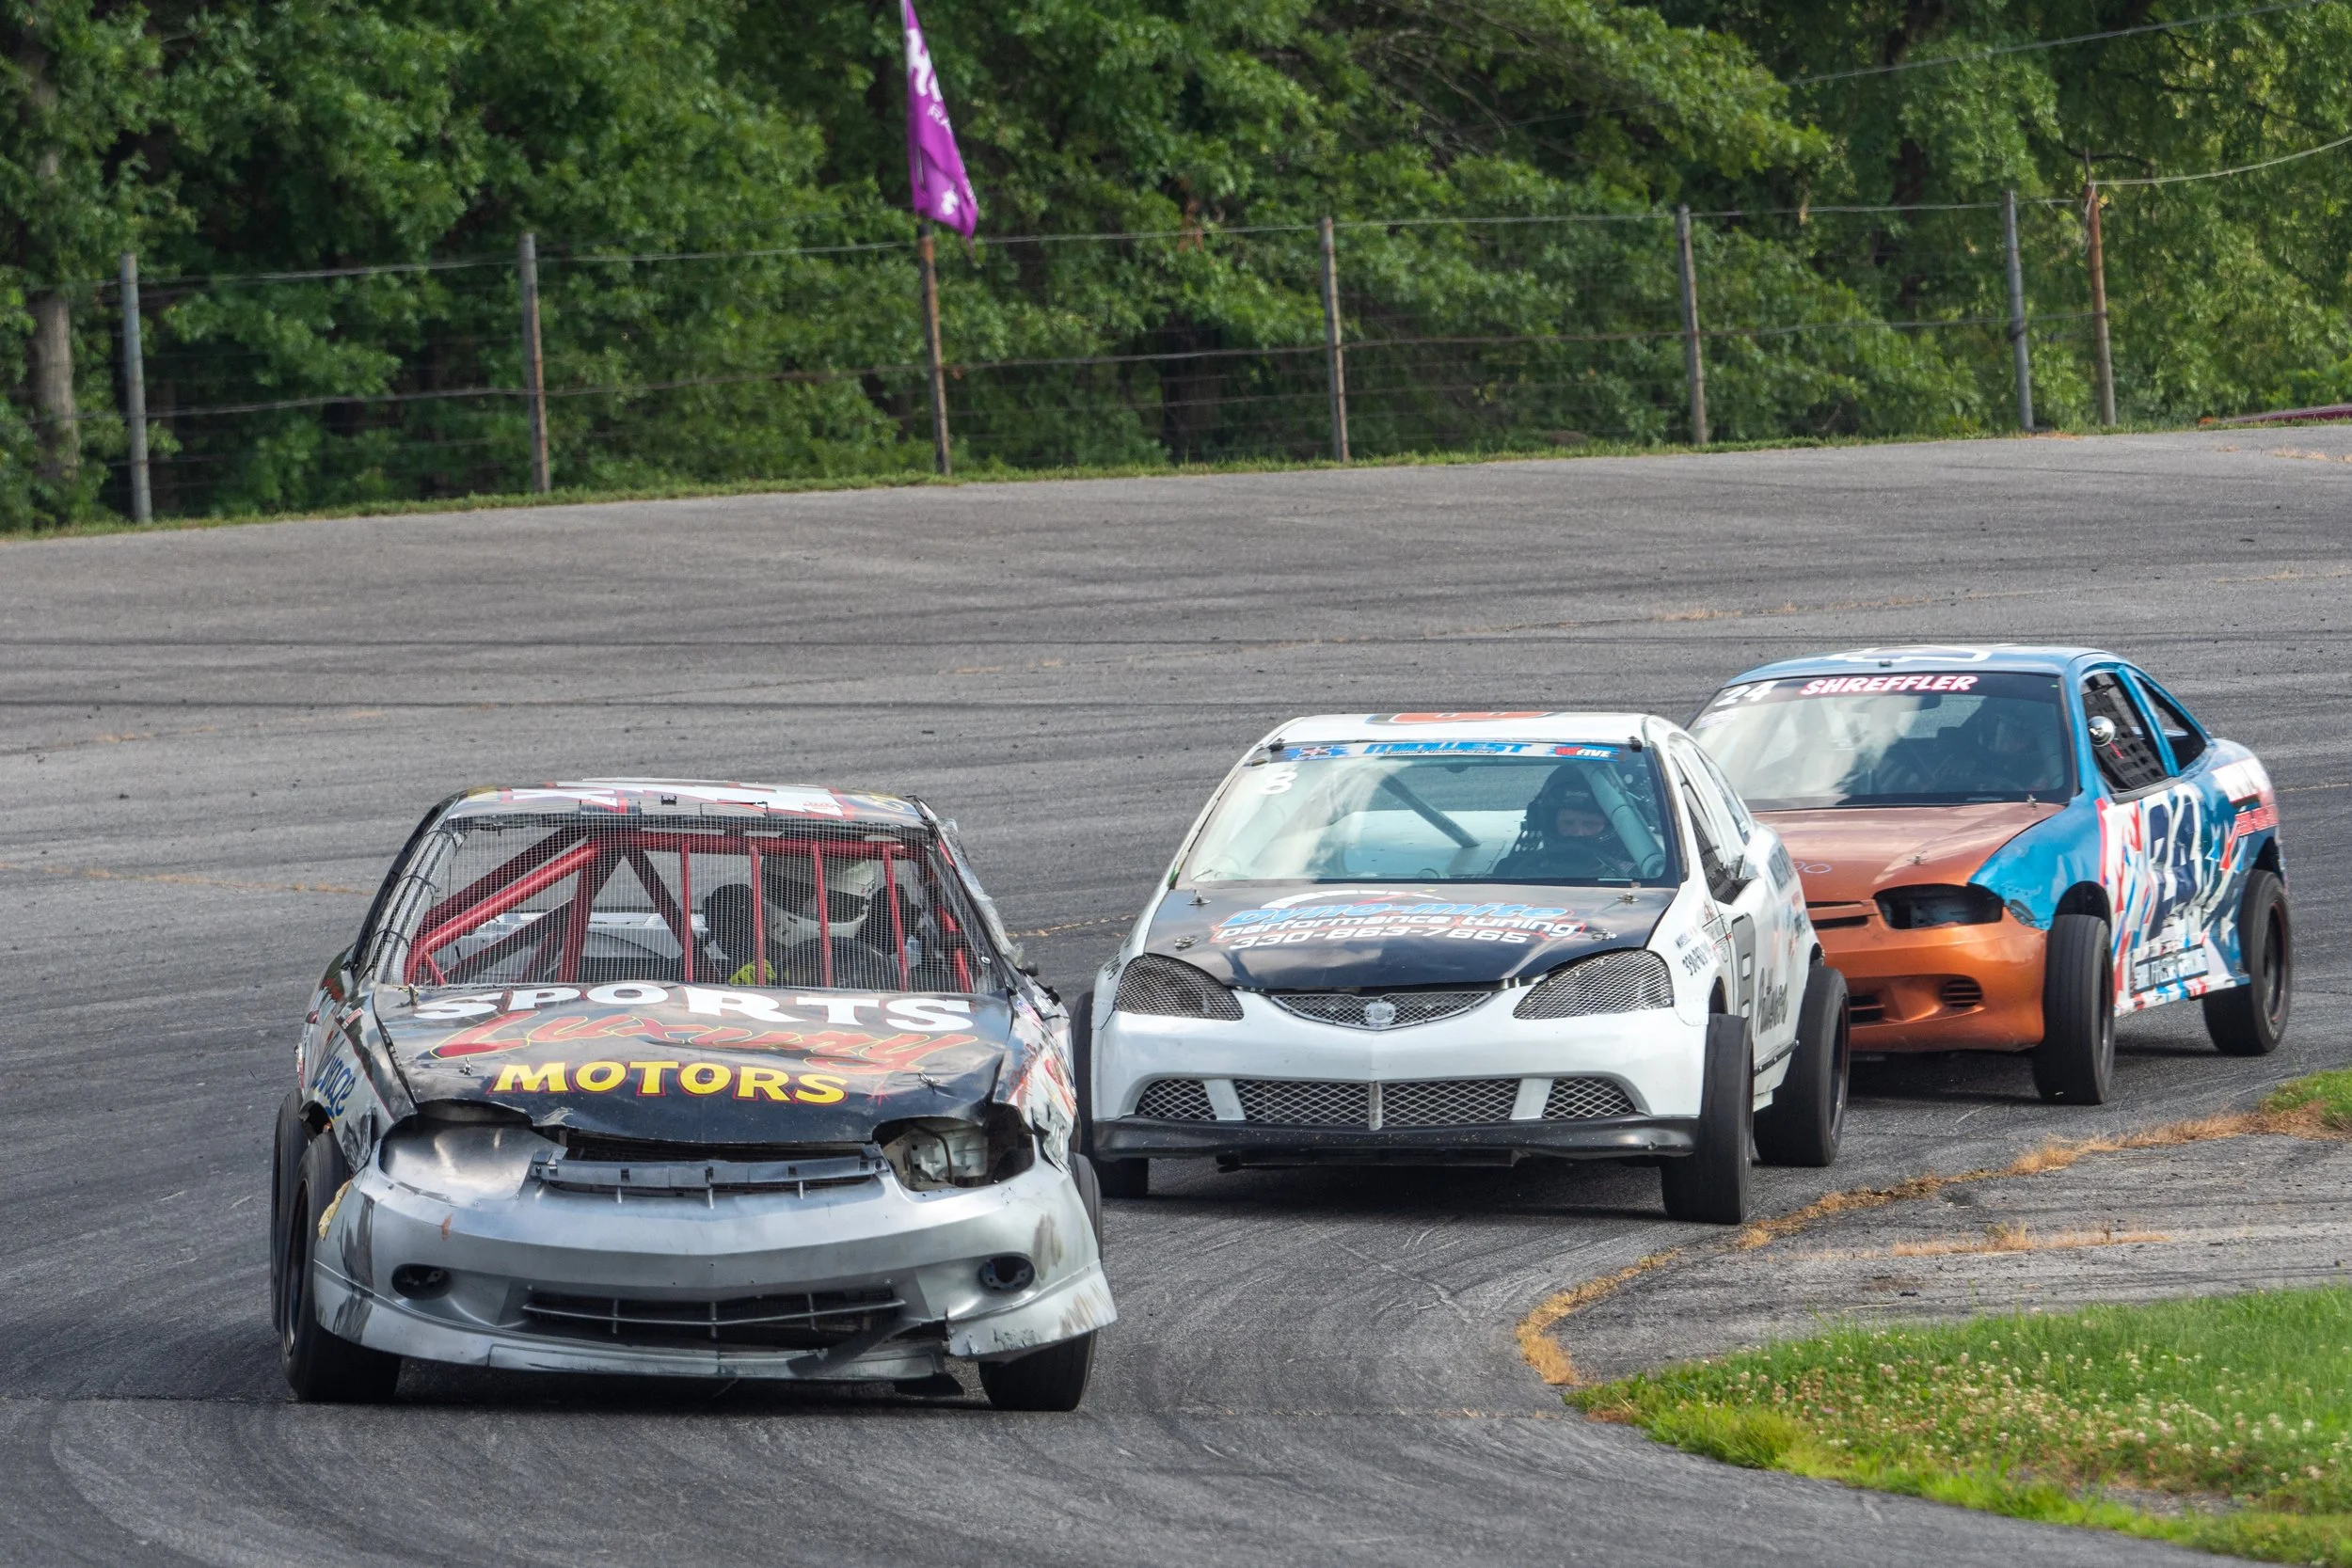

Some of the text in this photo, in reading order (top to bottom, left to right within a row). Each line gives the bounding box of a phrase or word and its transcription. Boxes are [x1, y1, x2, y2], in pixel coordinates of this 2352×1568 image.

[1714, 681, 1781, 706] 24
[1799, 674, 1979, 695] SHREFFLER
[1260, 770, 1298, 796] 8
[1217, 915, 1578, 939] performance tuning
[1228, 926, 1532, 951] 330-863-7665
[413, 981, 975, 1032] SPORTS
[489, 1060, 850, 1104] MOTORS
